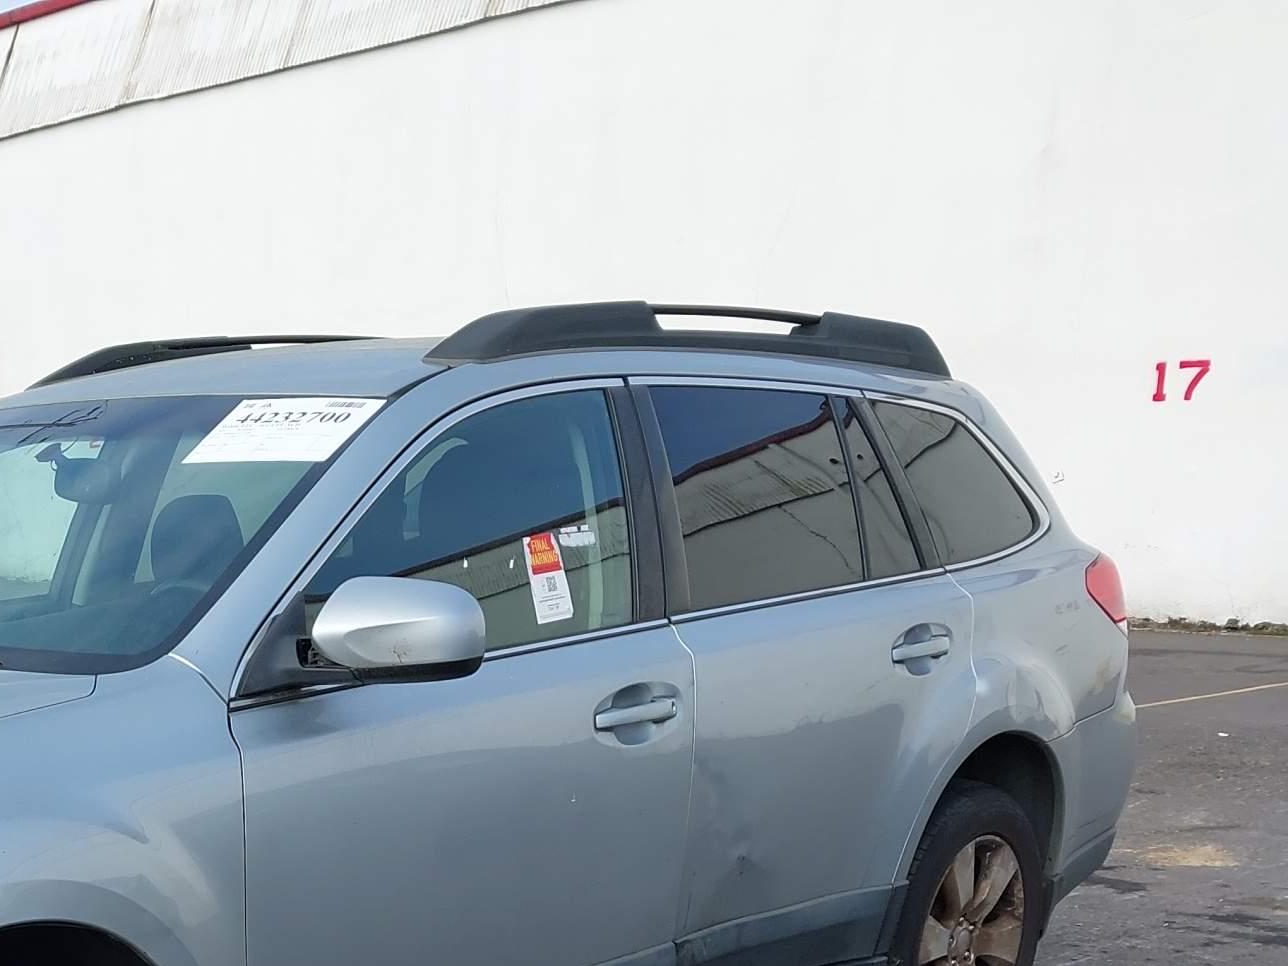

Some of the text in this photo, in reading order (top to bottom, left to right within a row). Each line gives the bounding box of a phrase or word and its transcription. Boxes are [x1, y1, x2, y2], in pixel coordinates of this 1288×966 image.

[1151, 359, 1211, 402] 17
[236, 411, 351, 424] 44232700
[530, 538, 550, 552] FINAL
